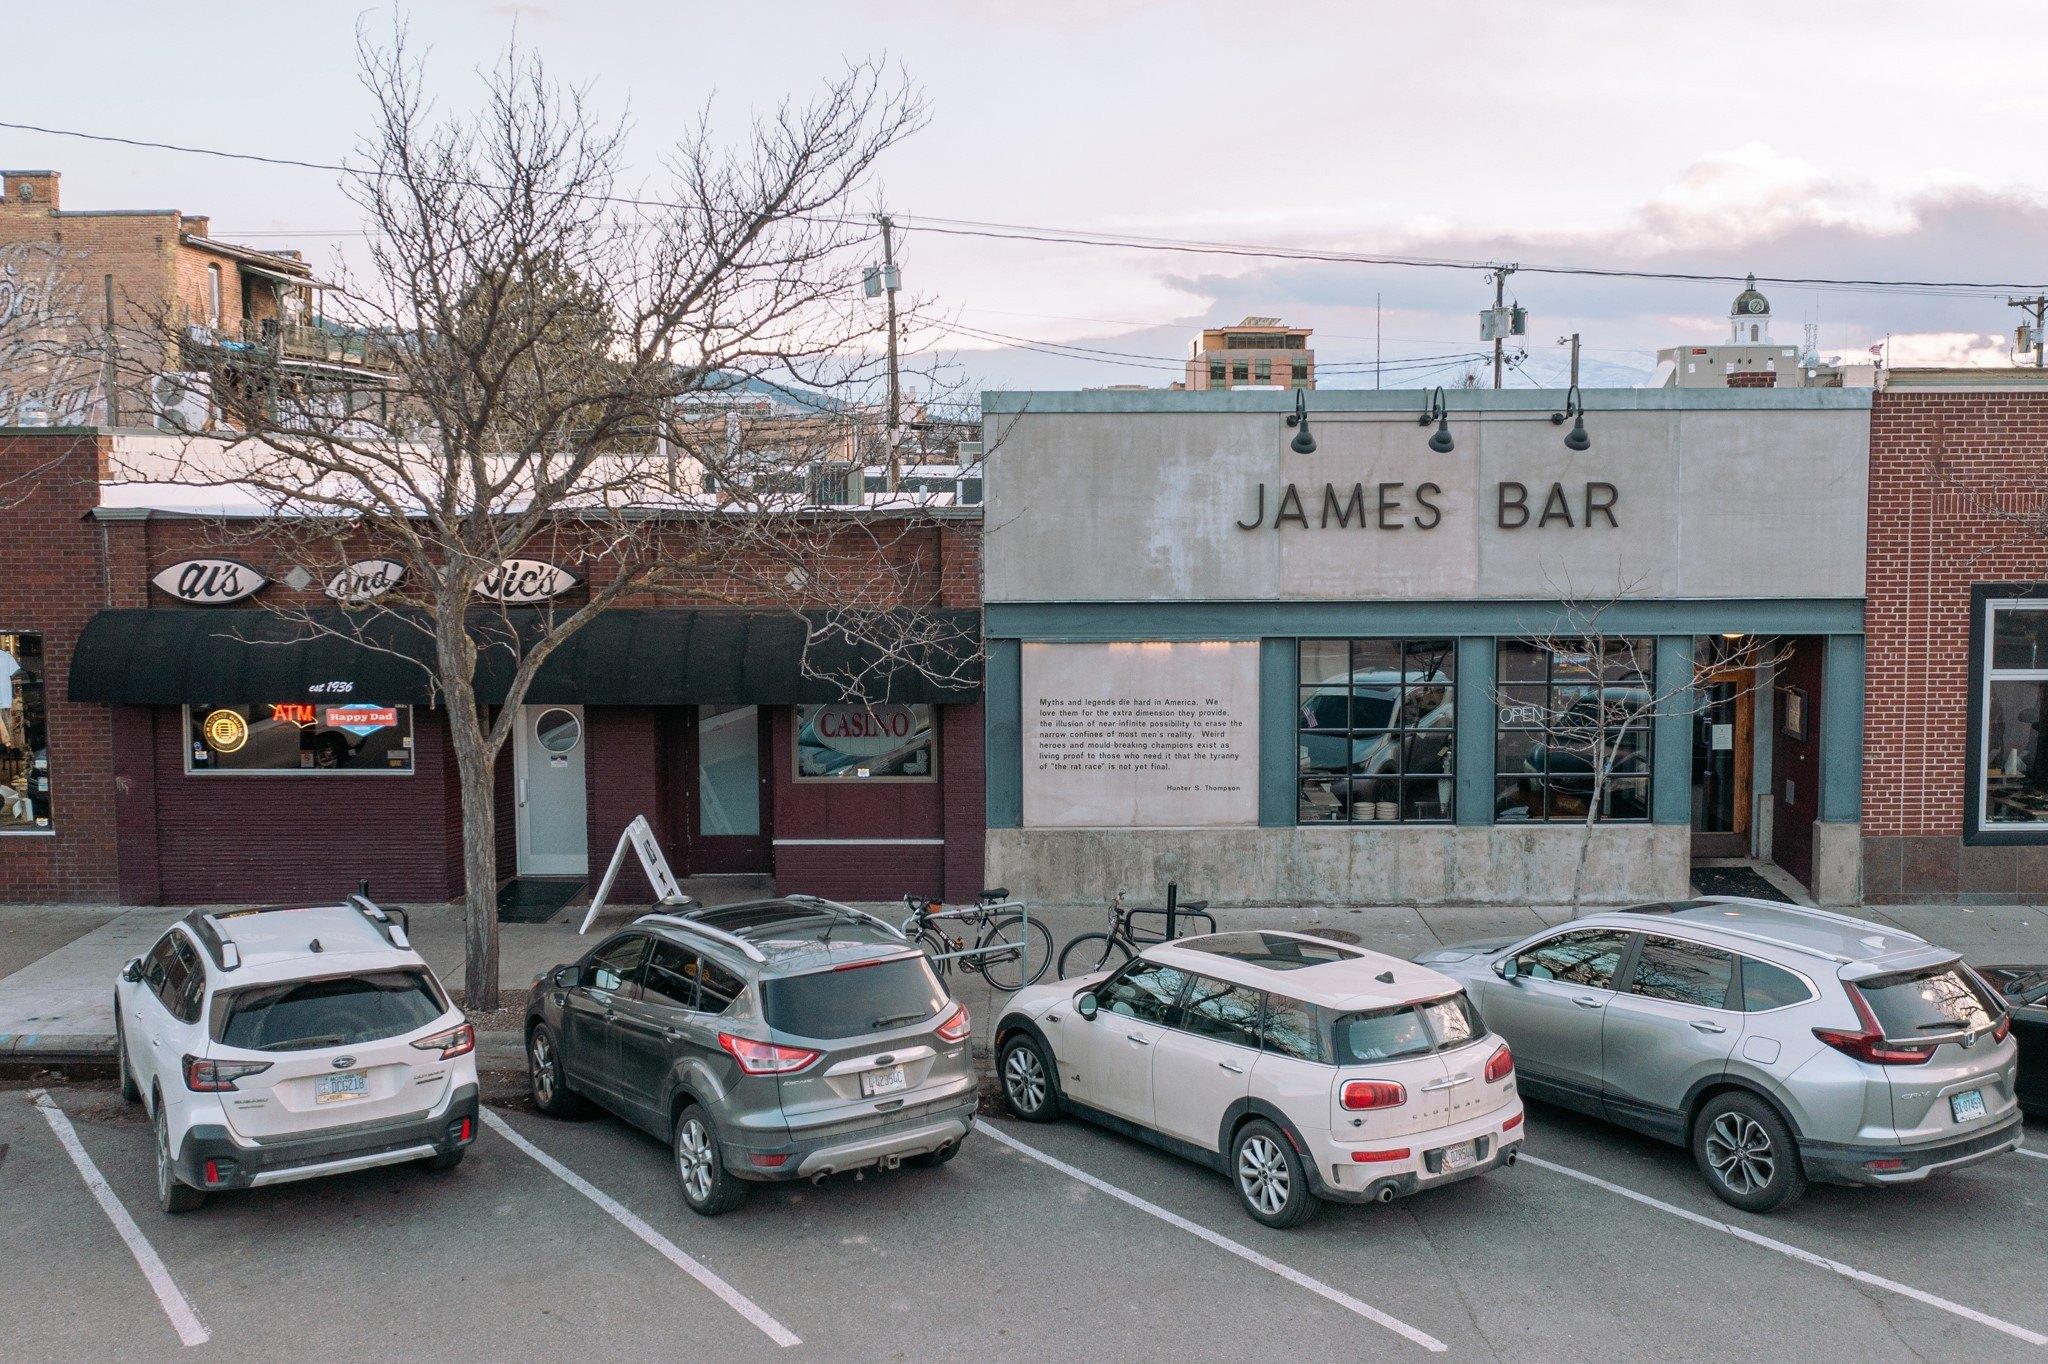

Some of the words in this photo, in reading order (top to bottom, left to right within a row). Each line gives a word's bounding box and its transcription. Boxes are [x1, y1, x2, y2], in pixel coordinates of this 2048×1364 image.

[1236, 482, 1442, 530] JAMES
[1497, 482, 1619, 529] BAR
[309, 683, 325, 692] est
[326, 681, 354, 692] 1936
[1040, 699, 1064, 708] Myths
[1085, 699, 1116, 708] legends
[1205, 698, 1219, 706] We
[273, 704, 313, 721] ATM
[330, 714, 368, 722] Happy
[370, 713, 393, 721] Dad
[1040, 709, 1056, 717] love
[1059, 709, 1078, 717] them
[1082, 709, 1093, 717] for
[1096, 709, 1109, 717] the
[1112, 709, 1132, 717] extra
[1135, 709, 1174, 717] dimension
[1178, 709, 1196, 718] they
[1500, 707, 1544, 724] OPEN
[820, 712, 909, 738] CASINO
[1150, 720, 1190, 729] possibility
[1107, 730, 1116, 738] of
[1166, 730, 1194, 740] reality.
[1202, 730, 1225, 738] Weird
[1040, 741, 1066, 749] heroes
[1070, 741, 1084, 749] and
[1088, 741, 1147, 750] mould-breaking
[1151, 741, 1193, 750] champions
[1197, 741, 1217, 749] exist
[1039, 752, 1060, 761] living
[1063, 752, 1083, 761] proof
[1087, 752, 1096, 760] to
[1099, 752, 1121, 760] those
[1124, 752, 1140, 760] who
[1143, 752, 1162, 760] need
[1166, 752, 1173, 760] it
[1174, 752, 1190, 760] that
[1194, 752, 1206, 760] the
[1210, 752, 1240, 762] tyranny
[1039, 763, 1048, 771] of
[1051, 763, 1068, 771] "the
[1070, 763, 1082, 771] rat
[1084, 763, 1105, 771] race"
[1108, 763, 1116, 771] is
[1119, 763, 1132, 771] not
[1134, 763, 1148, 772] yet
[1151, 762, 1170, 771] final.
[1167, 784, 1191, 792] Hunter
[1194, 784, 1203, 792] S.
[1205, 784, 1240, 793] Thompson
[332, 1078, 365, 1093] DCG218
